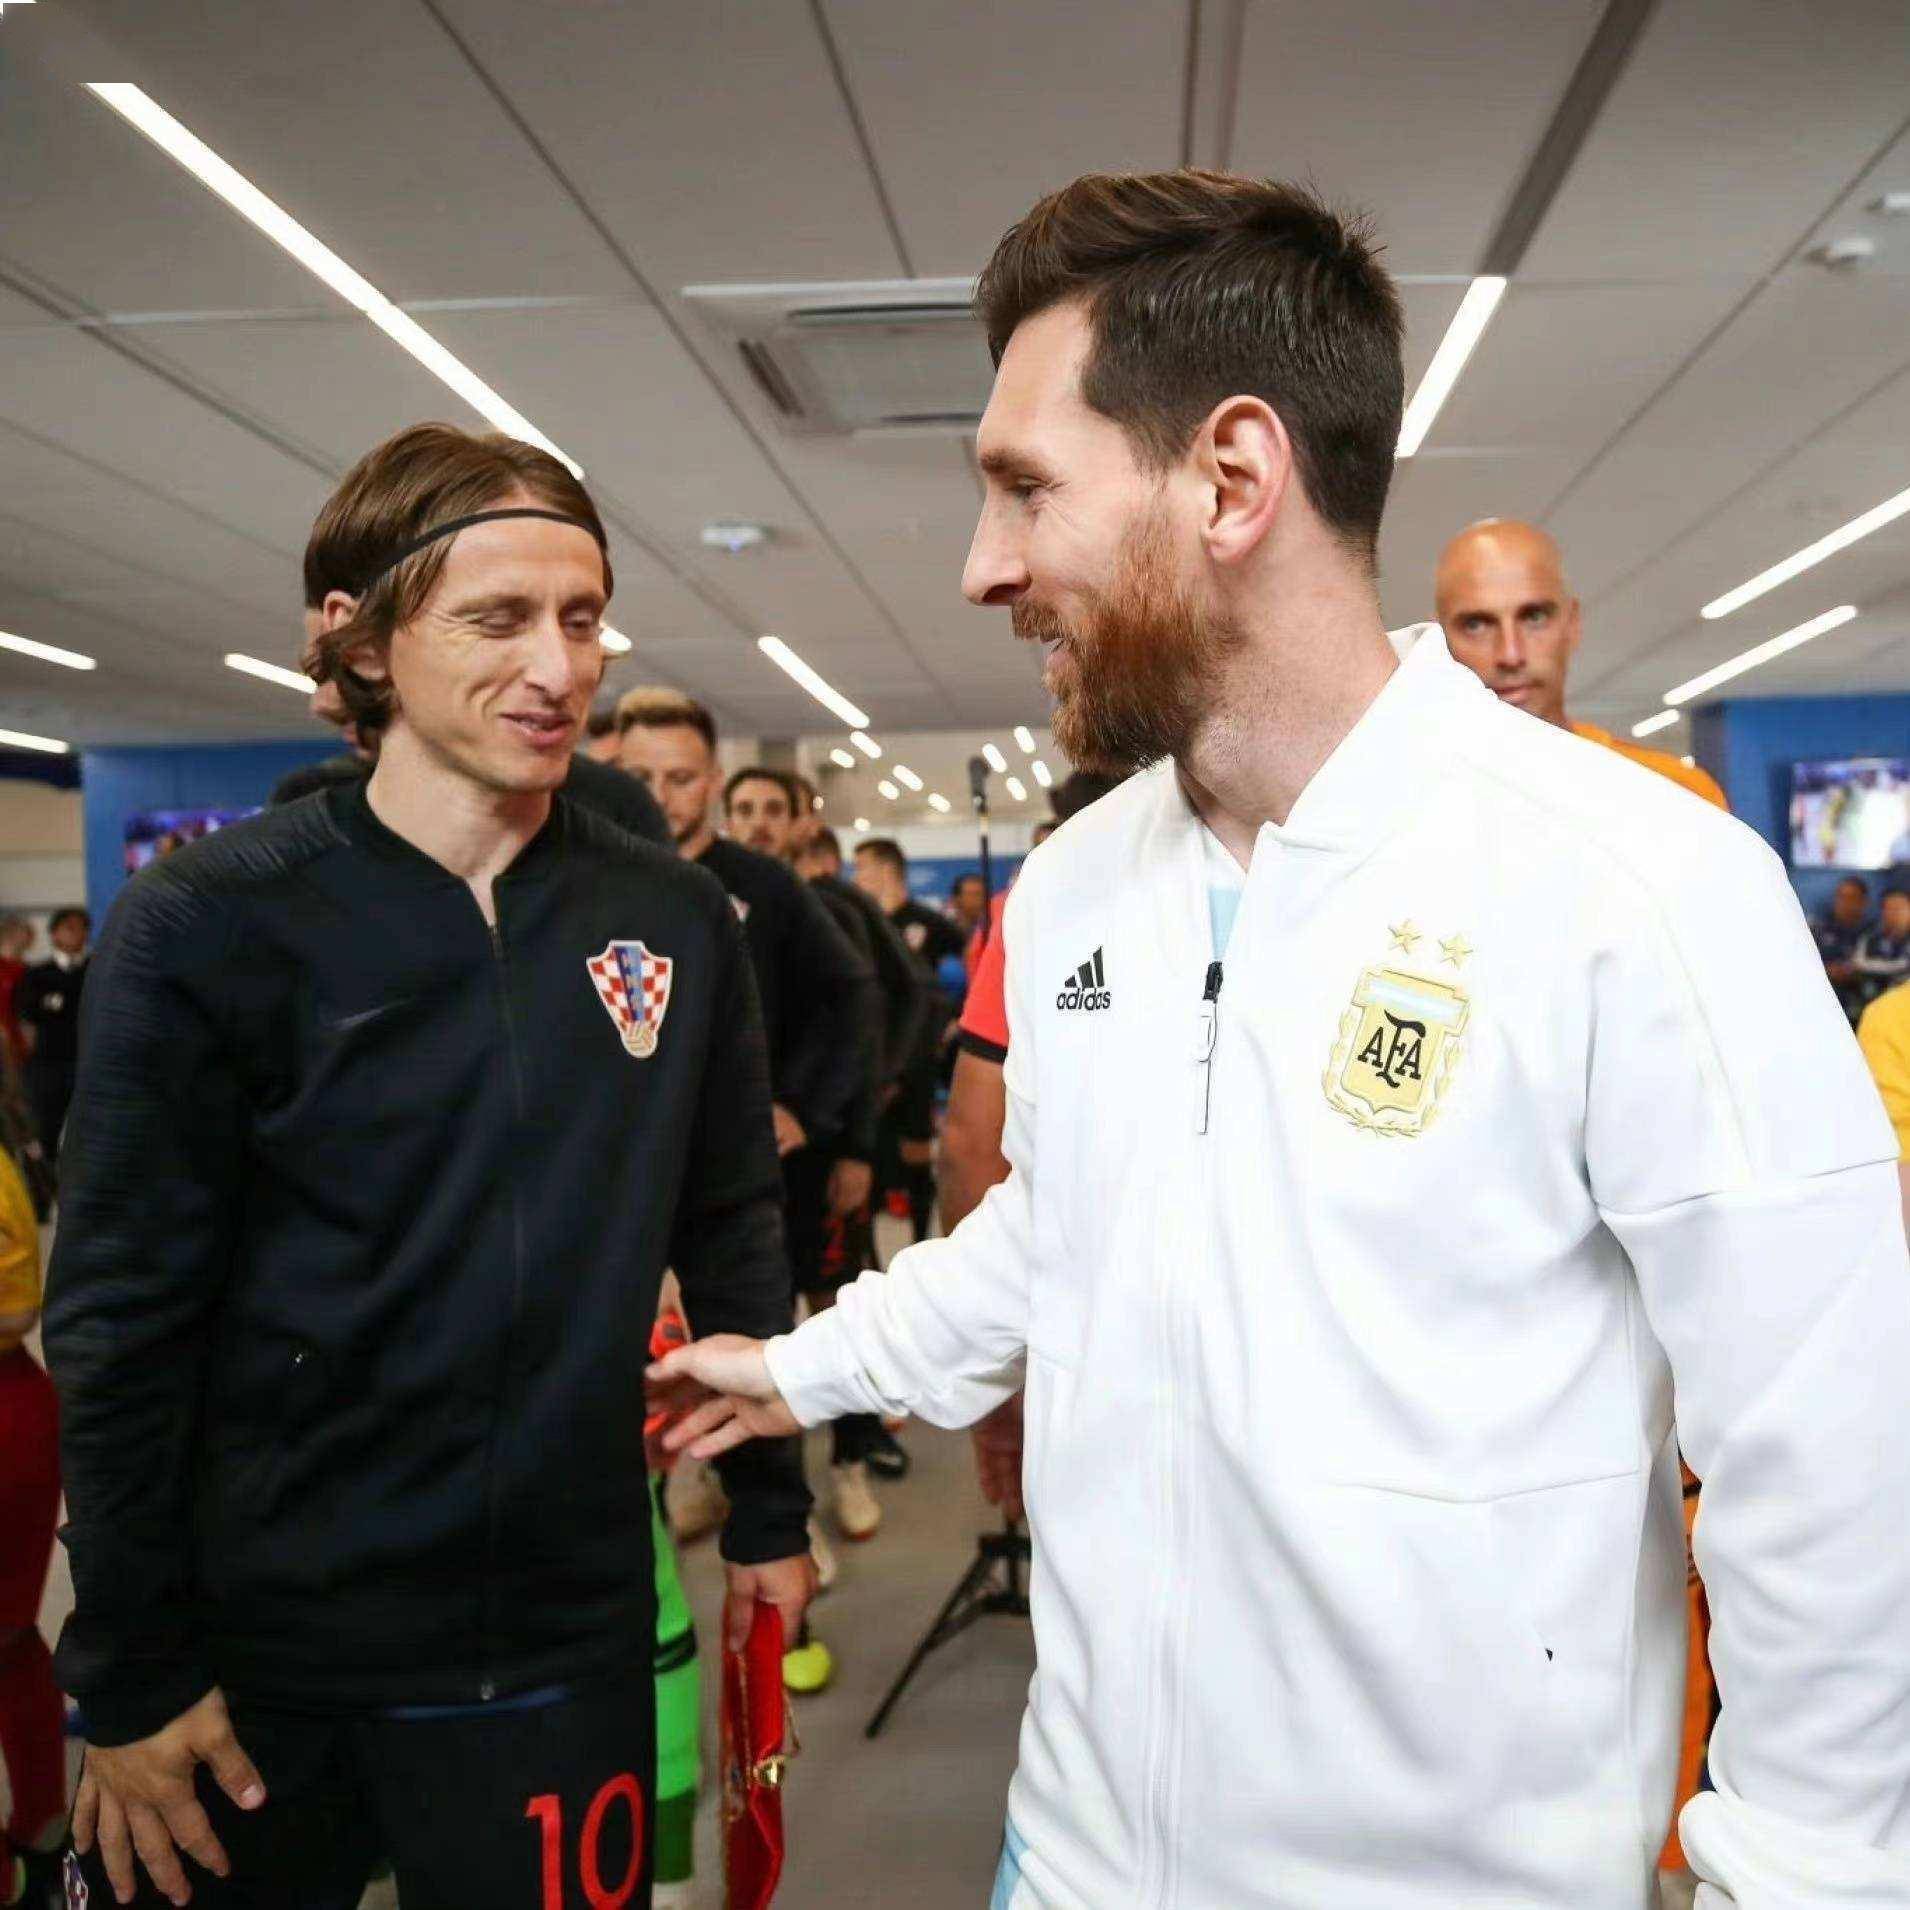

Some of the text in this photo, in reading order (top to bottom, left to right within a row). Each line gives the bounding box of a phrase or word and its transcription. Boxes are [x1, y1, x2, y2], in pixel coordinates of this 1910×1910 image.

[1056, 987, 1111, 1011] adidas
[1357, 1009, 1426, 1088] AFA
[524, 1773, 645, 1910] 10
